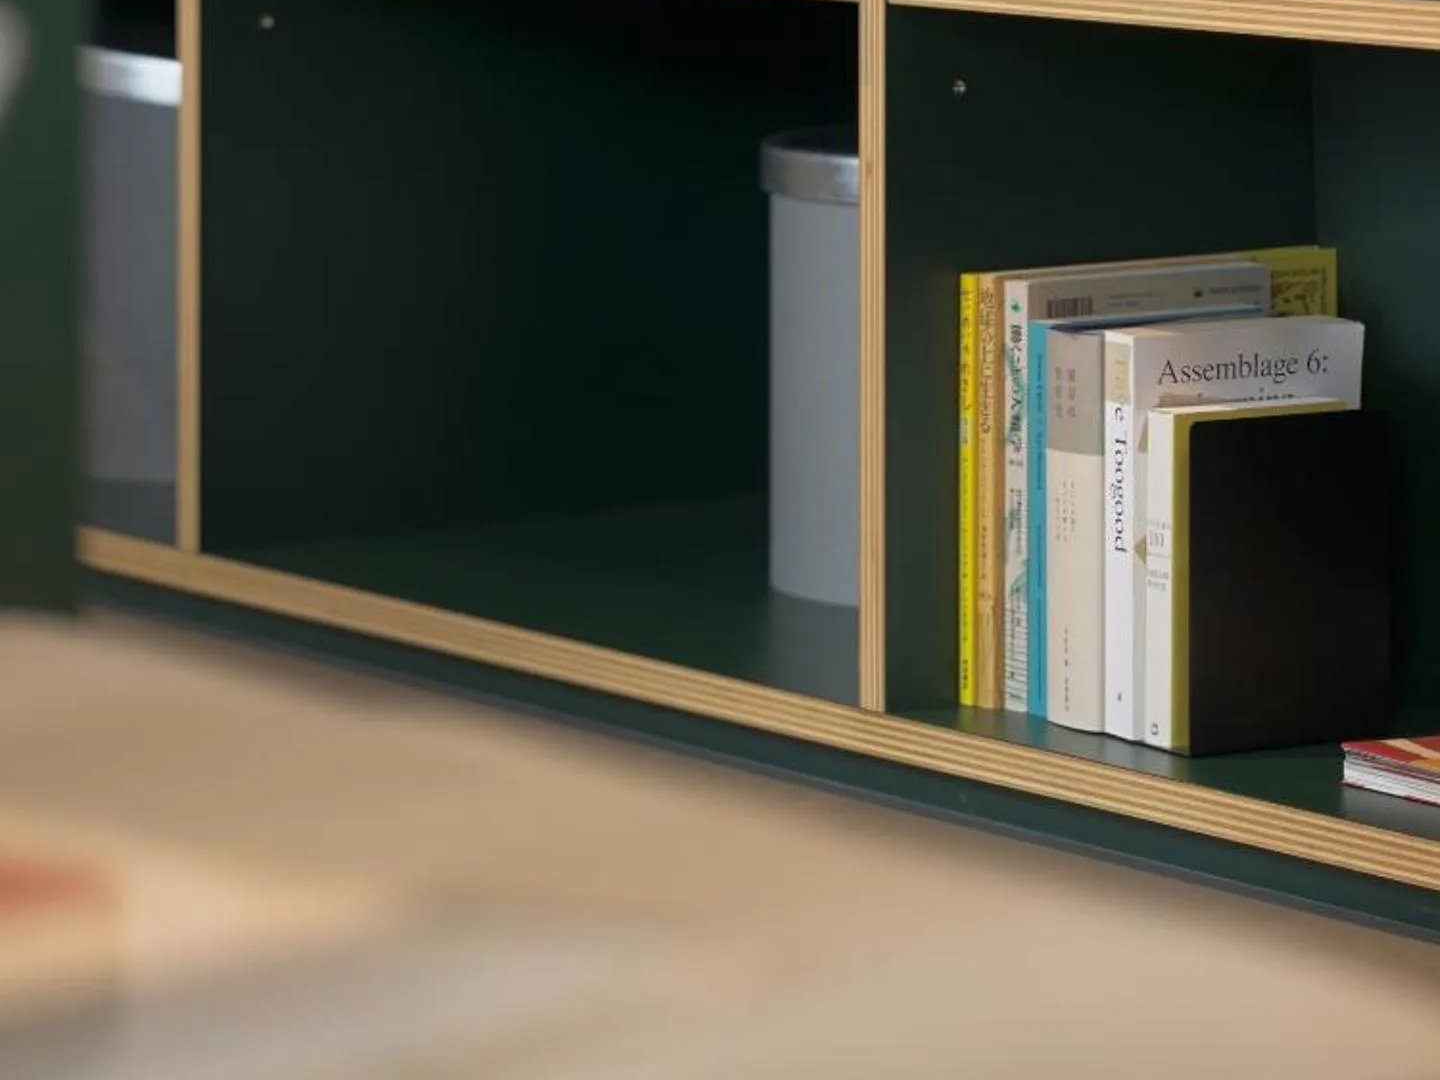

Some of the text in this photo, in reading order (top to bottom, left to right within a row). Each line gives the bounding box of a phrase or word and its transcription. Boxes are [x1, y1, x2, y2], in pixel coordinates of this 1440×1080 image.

[1157, 349, 1329, 386] Assemblage 6:
[1110, 438, 1129, 552] Toogood
